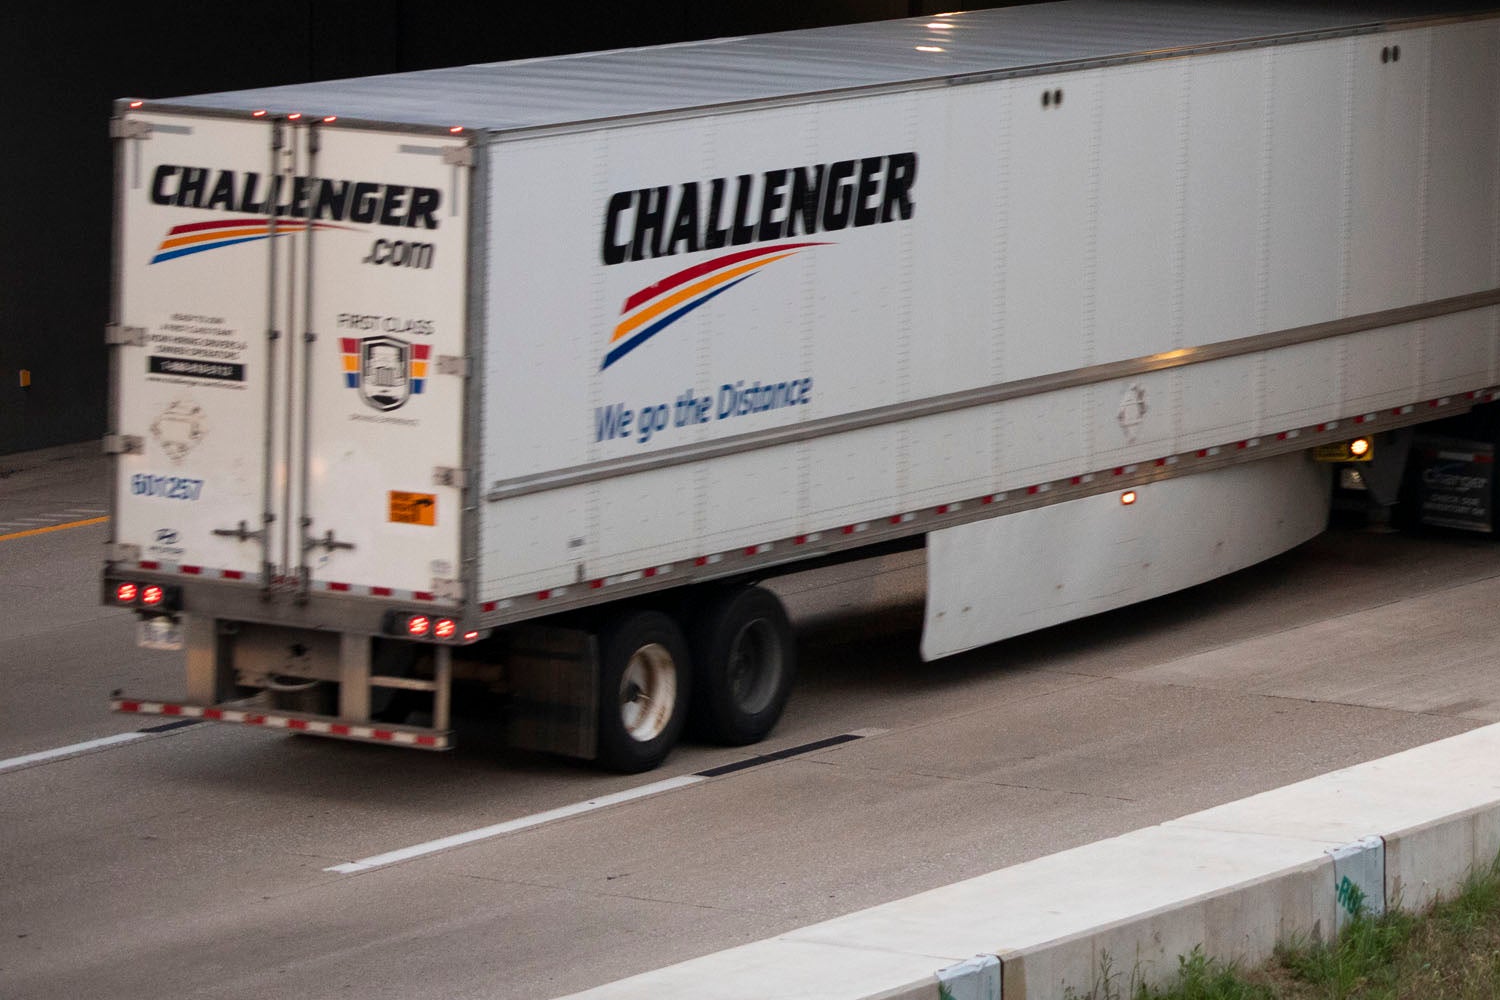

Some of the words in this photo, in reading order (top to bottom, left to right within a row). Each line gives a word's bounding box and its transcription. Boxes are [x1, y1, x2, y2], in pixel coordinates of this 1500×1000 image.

[151, 164, 441, 230] CHALLENGER
[601, 151, 919, 266] CHALLENGER
[362, 238, 435, 270] .com
[594, 402, 633, 443] We
[637, 403, 671, 444] go
[674, 388, 712, 428] the
[716, 379, 813, 421] Distance
